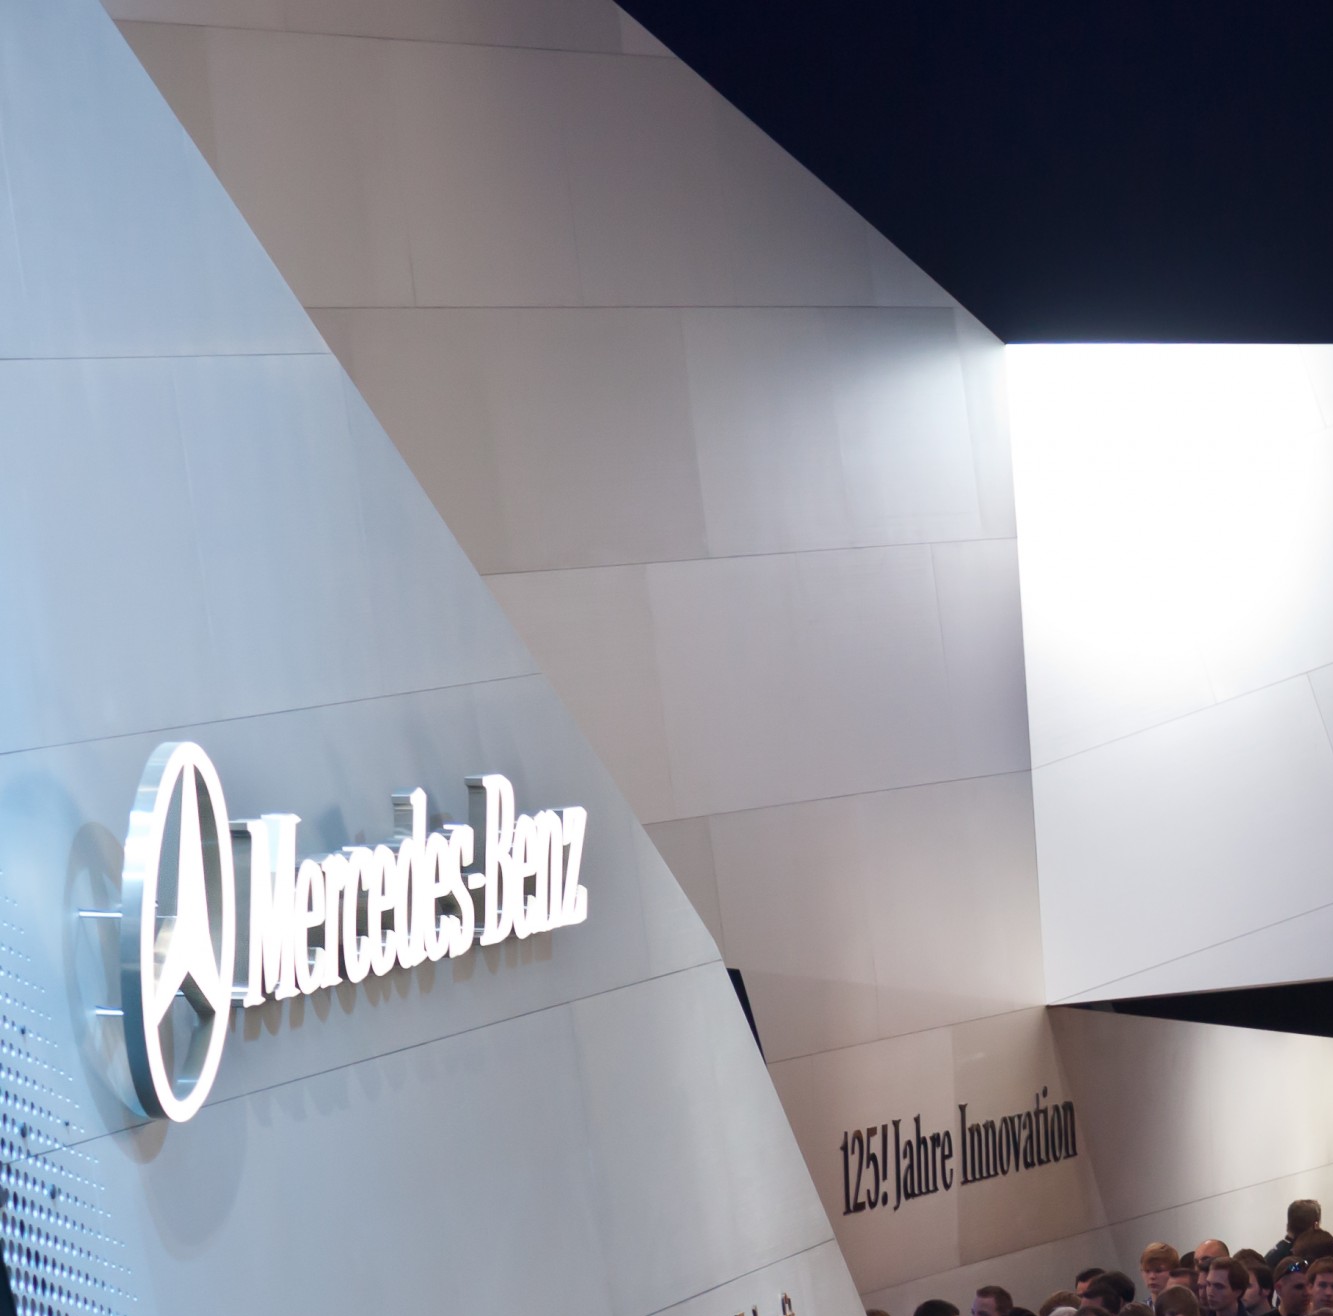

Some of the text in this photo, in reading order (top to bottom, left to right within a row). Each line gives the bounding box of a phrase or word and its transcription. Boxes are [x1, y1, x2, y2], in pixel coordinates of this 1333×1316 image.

[240, 773, 588, 1007] Mercedes-Benz
[840, 1086, 1078, 1215] 125! Jahre Innovation
